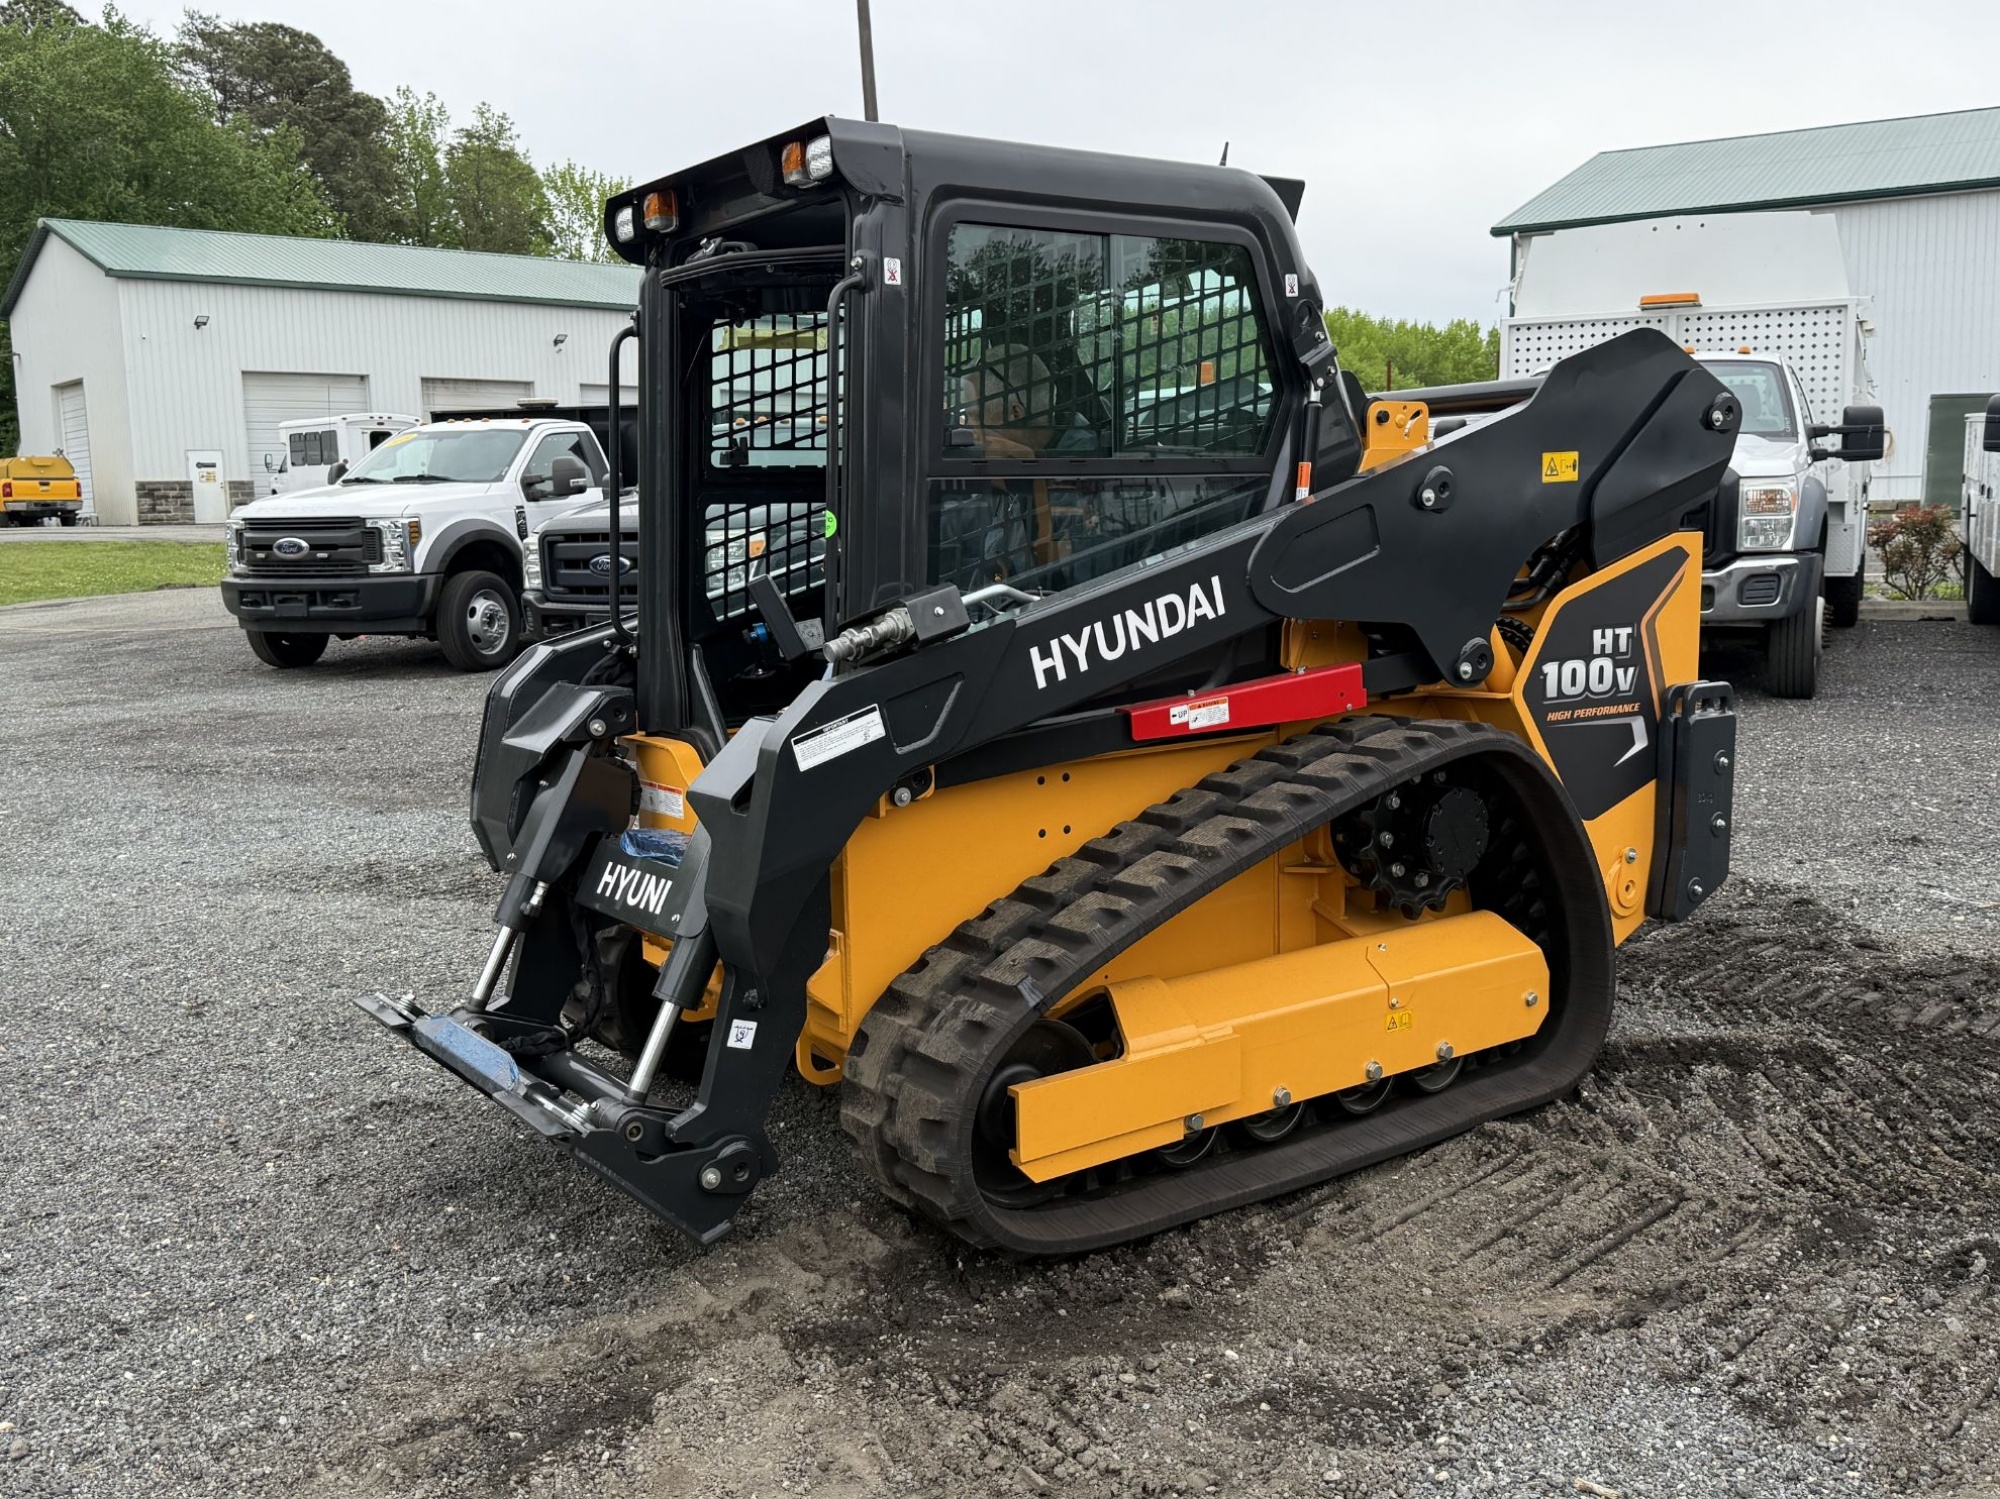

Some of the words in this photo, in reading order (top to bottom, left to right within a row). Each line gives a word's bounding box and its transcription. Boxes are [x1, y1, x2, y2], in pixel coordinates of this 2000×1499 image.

[1029, 575, 1226, 690] HYUNDAI
[1592, 626, 1633, 655] HT
[1177, 710, 1188, 719] UP
[1546, 710, 1572, 721] HIGH
[1573, 702, 1641, 719] PERFORMANCE
